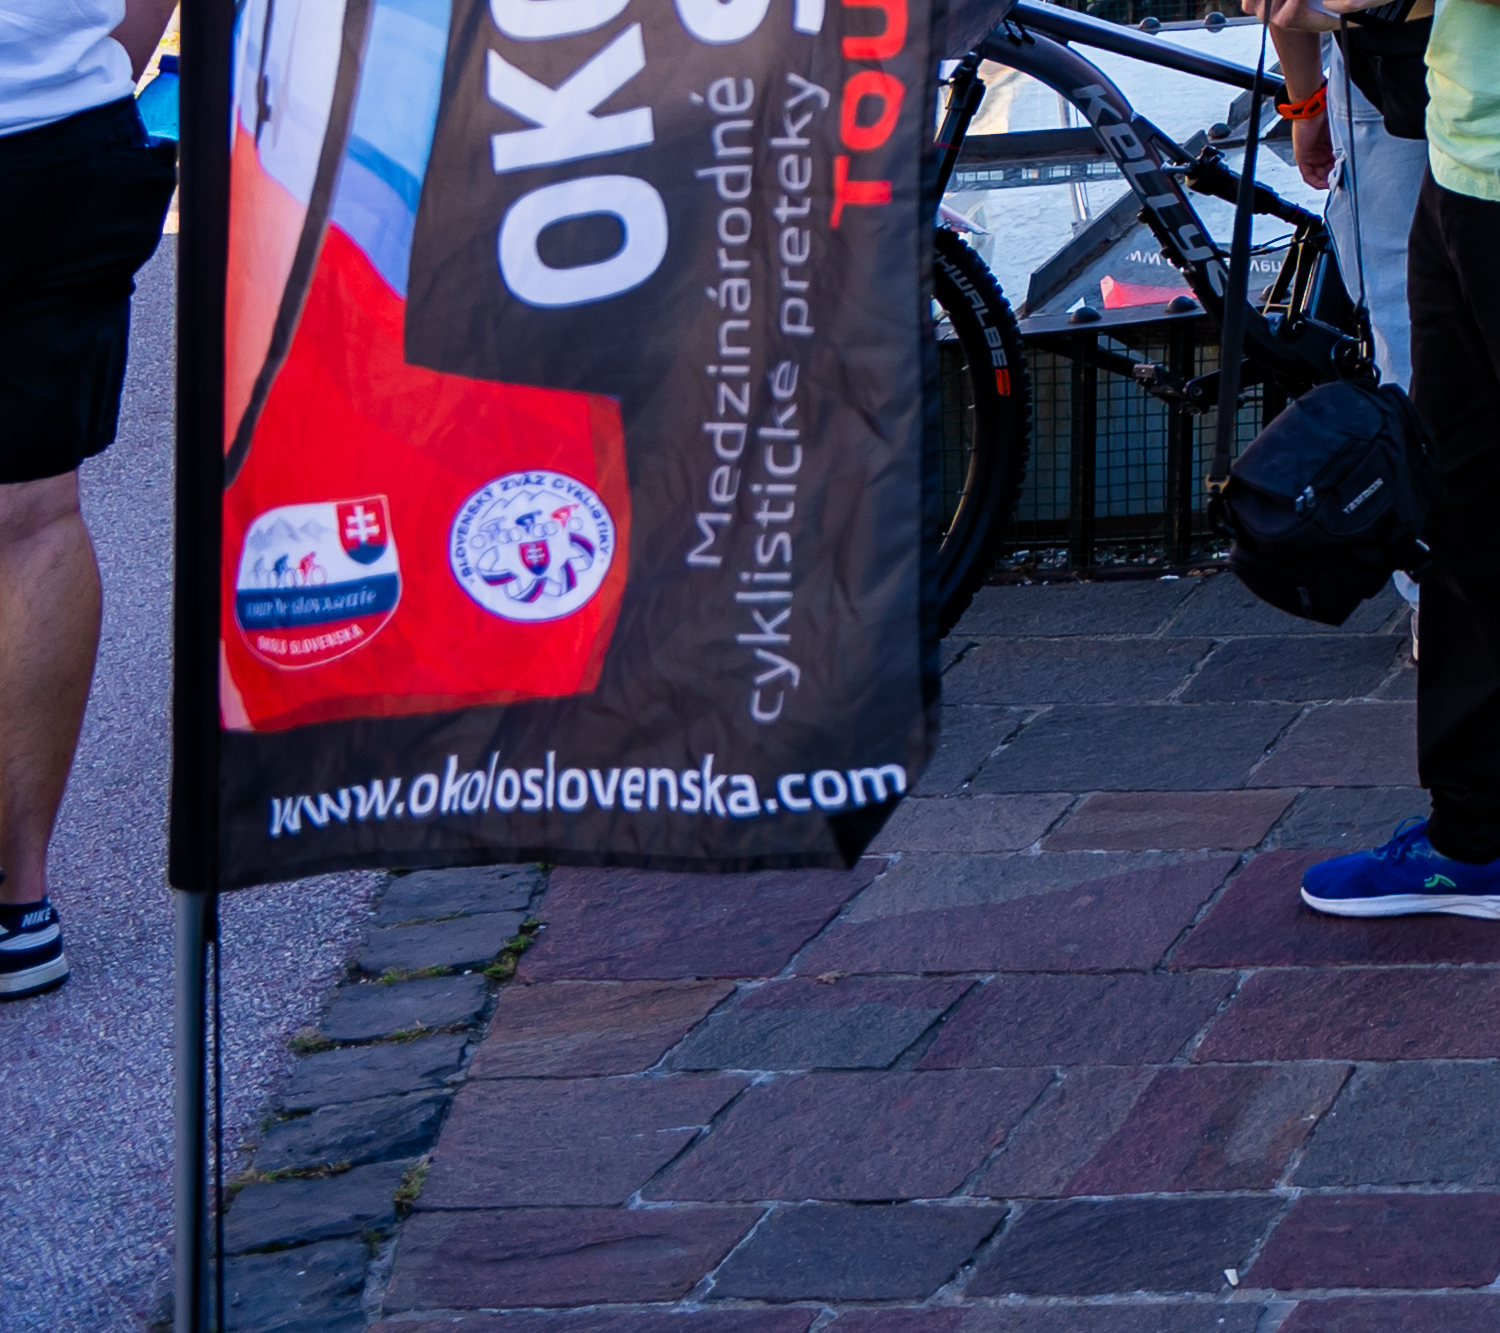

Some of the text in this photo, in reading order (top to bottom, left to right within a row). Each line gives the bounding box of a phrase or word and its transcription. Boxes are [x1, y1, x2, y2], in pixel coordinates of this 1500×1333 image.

[772, 72, 831, 338] preteky
[688, 75, 755, 569] Medzinárodné
[269, 750, 907, 836] www.okoloslovenska.com
[21, 907, 52, 928] NIKE
